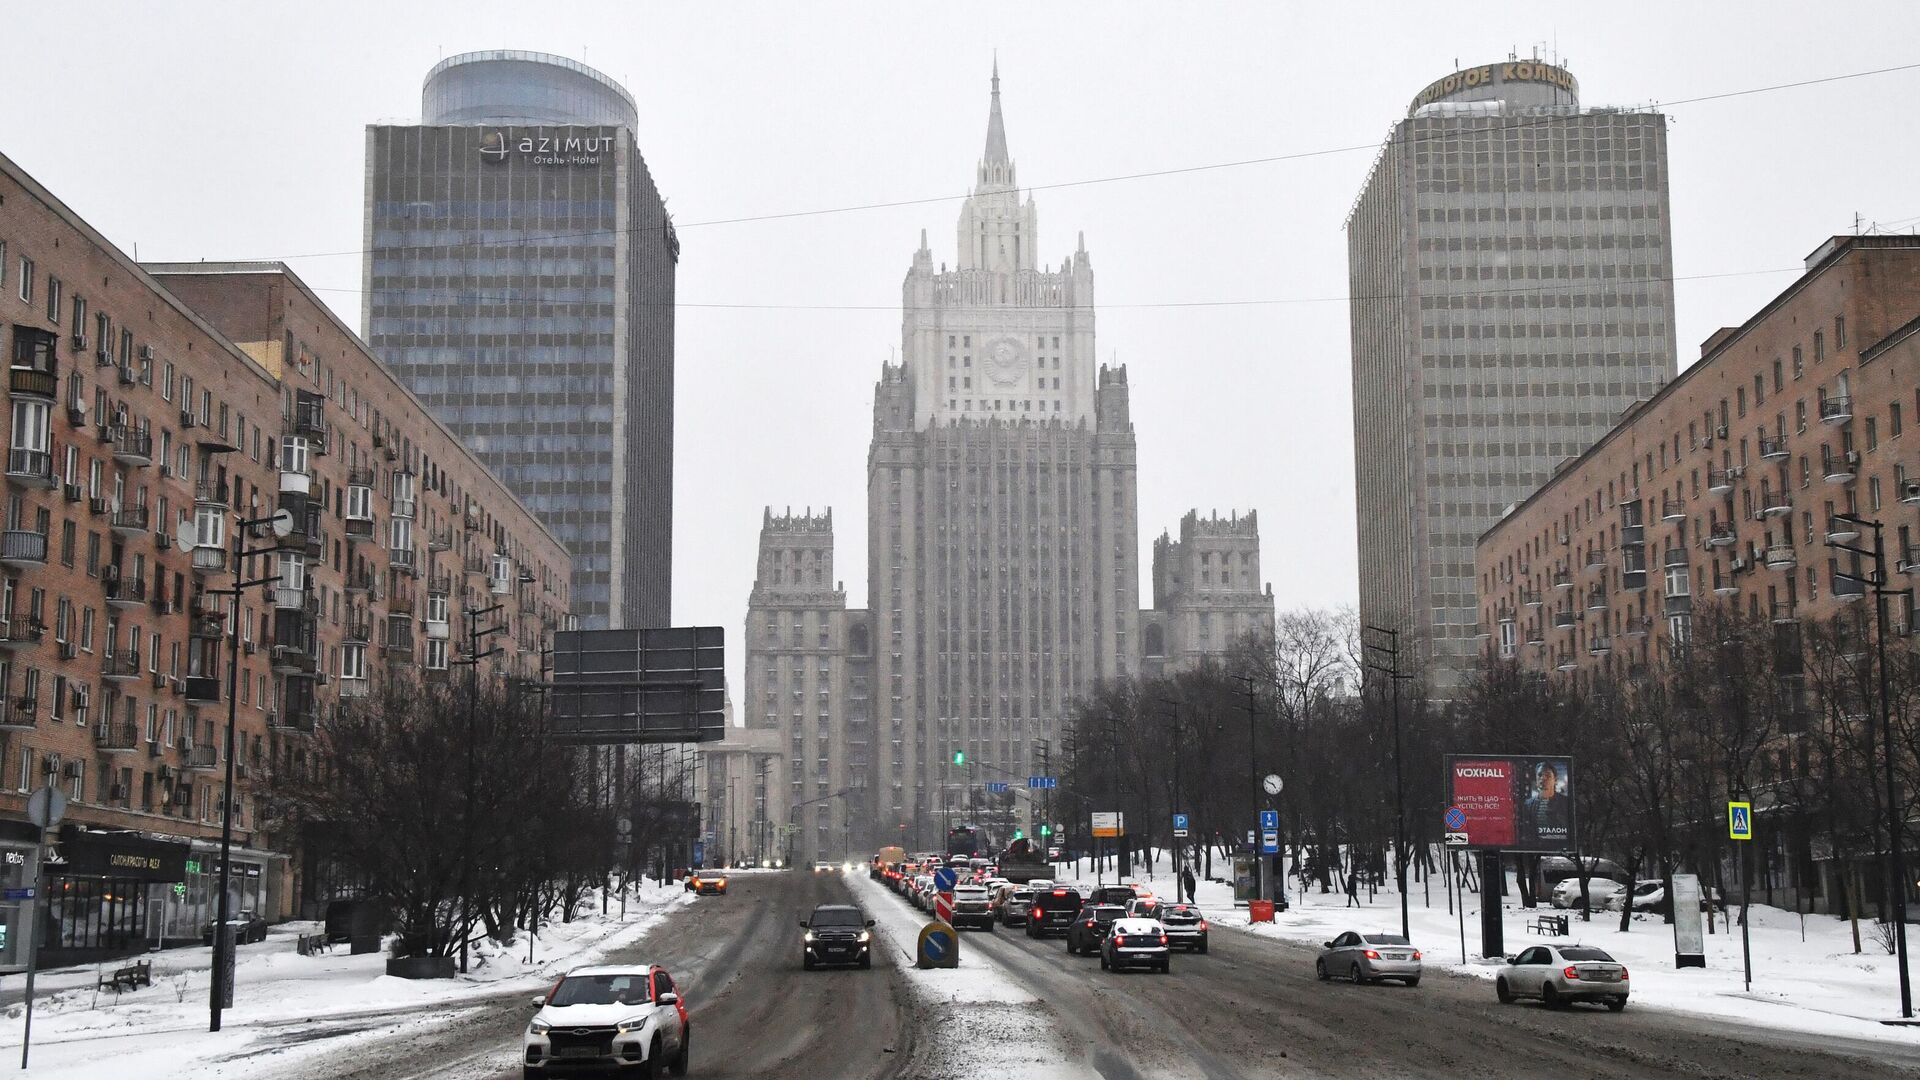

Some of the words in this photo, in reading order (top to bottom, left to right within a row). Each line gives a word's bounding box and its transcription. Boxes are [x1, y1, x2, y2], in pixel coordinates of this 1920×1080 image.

[1503, 64, 1573, 89] КОЛЬЦО
[533, 156, 565, 164] Отель
[572, 155, 599, 164] Hotel
[1456, 768, 1505, 778] VOXHALL
